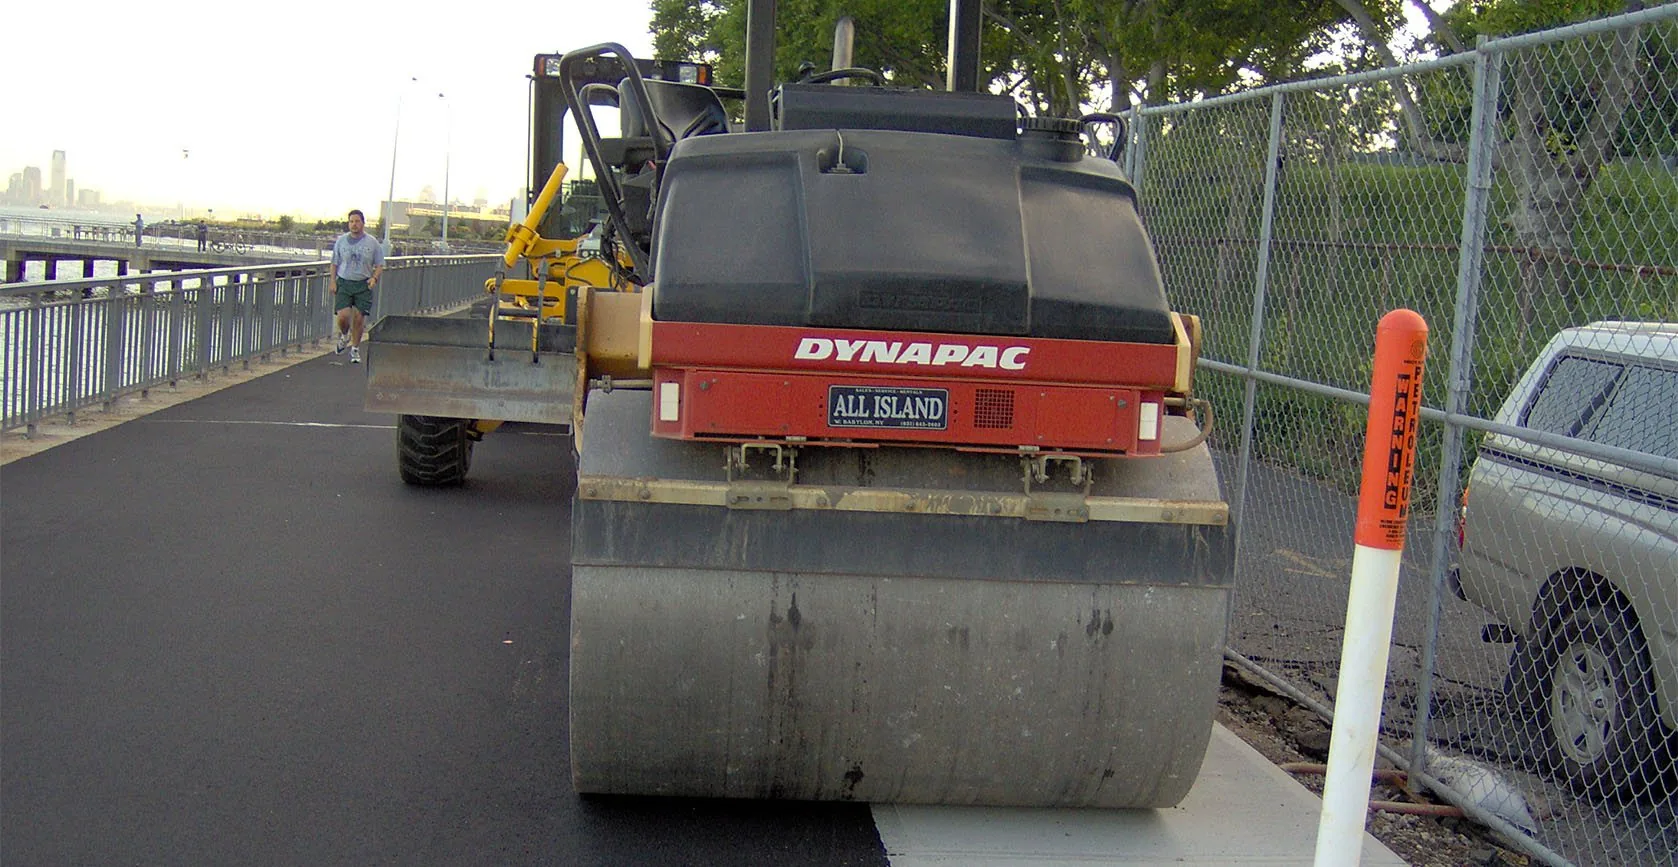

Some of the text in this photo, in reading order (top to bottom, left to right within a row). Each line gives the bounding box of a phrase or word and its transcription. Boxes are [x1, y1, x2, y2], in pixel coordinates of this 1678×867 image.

[794, 338, 1031, 370] DYNAPAC
[833, 394, 944, 420] ALL ISLAND
[1385, 376, 1410, 507] WARNING
[1399, 366, 1421, 518] PETROLEUM
